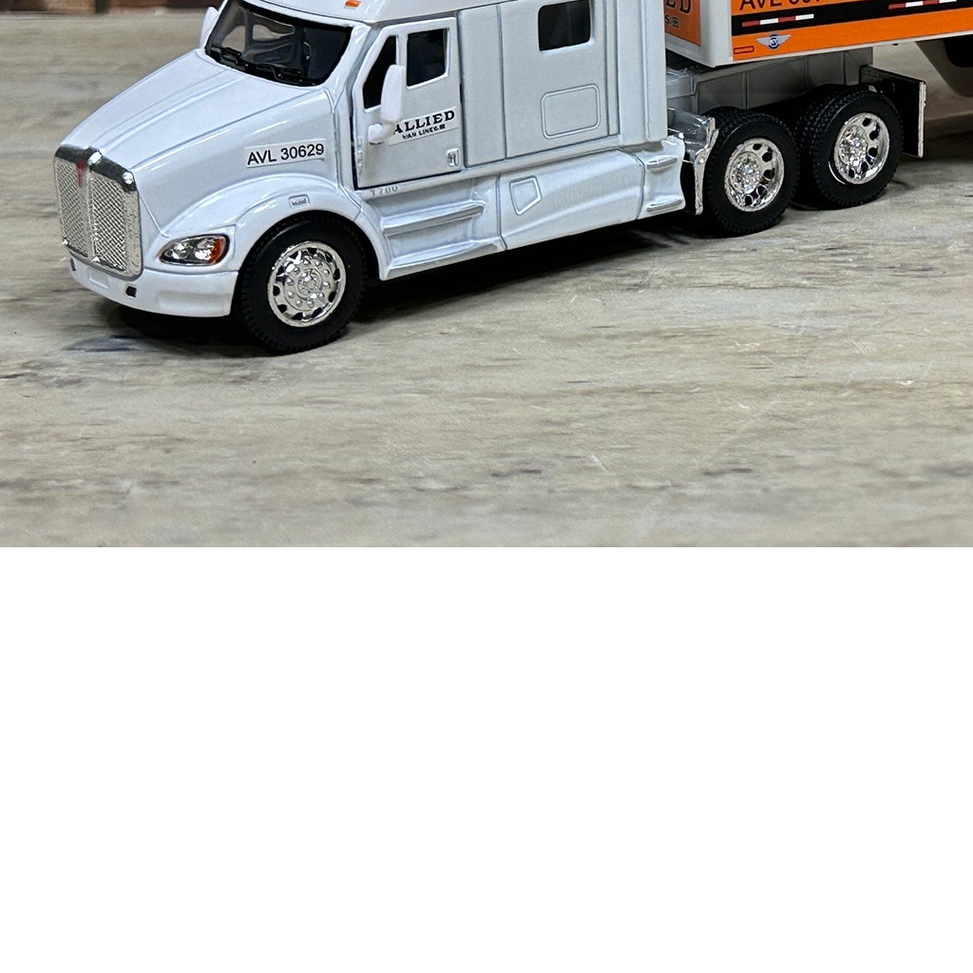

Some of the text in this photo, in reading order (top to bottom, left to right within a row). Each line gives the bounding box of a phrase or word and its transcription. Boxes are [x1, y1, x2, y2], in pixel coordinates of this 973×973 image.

[394, 109, 455, 135] ALLIED
[247, 143, 324, 165] AVL 30629
